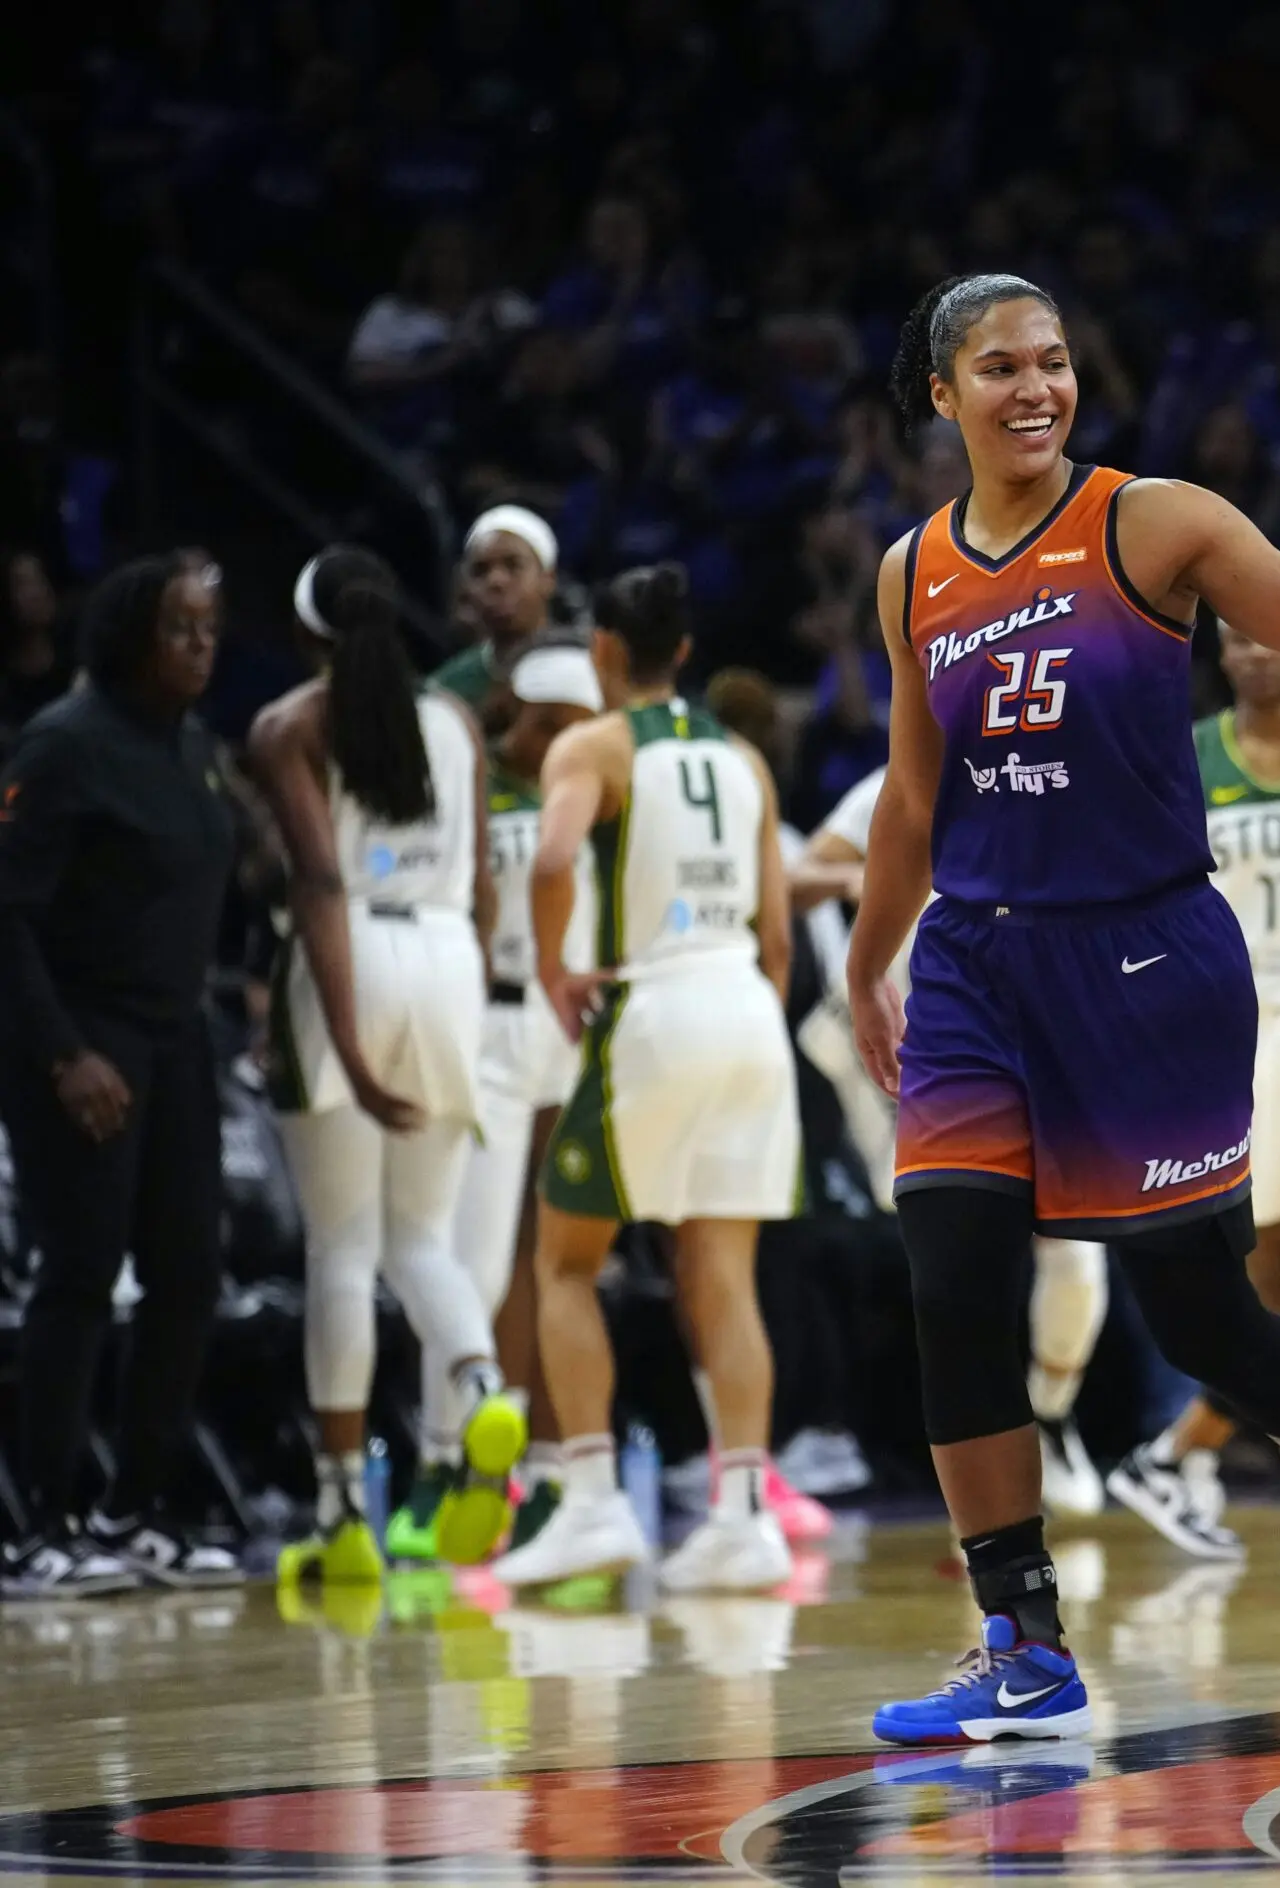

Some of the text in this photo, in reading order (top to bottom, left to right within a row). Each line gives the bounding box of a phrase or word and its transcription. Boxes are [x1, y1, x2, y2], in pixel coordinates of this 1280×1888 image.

[927, 587, 1077, 682] Phoenix
[982, 648, 1074, 737] 25
[679, 759, 723, 842] 4
